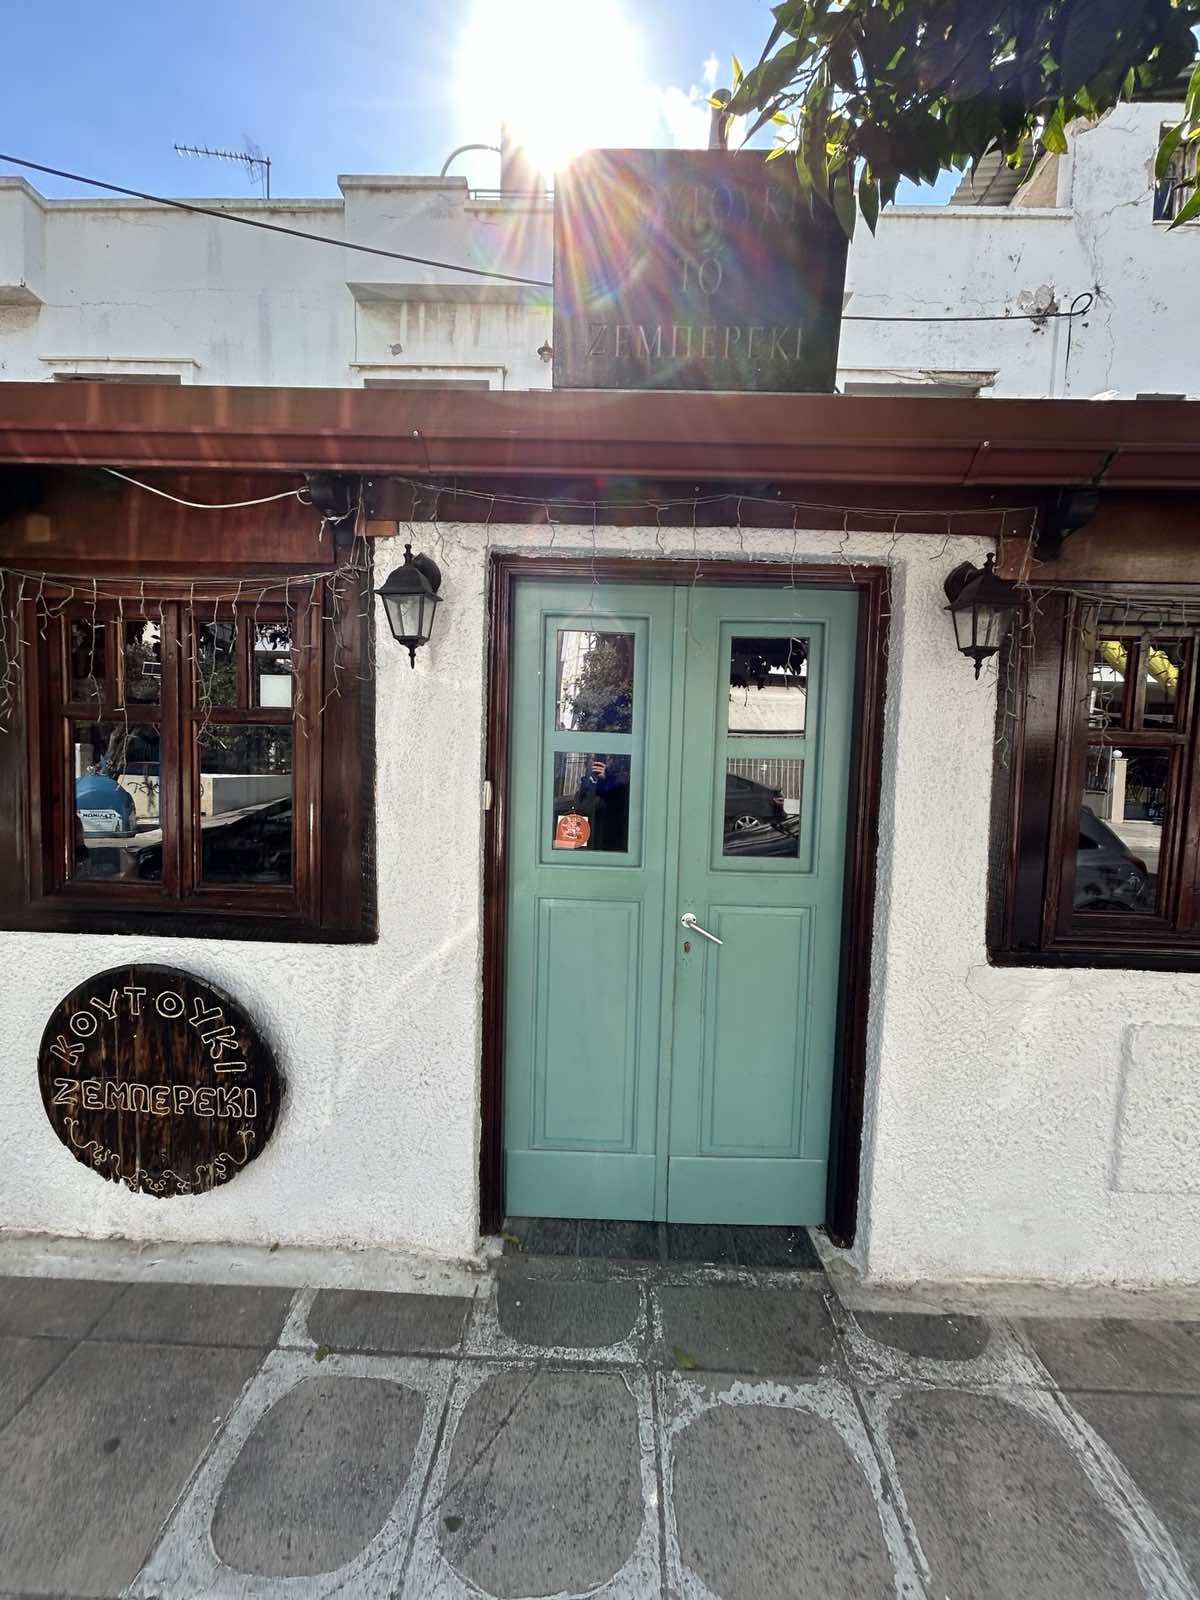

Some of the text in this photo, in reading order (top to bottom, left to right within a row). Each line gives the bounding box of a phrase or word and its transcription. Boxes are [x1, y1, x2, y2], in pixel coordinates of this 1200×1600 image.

[584, 322, 803, 361] ΖΕΜΠΕΡΕΚΙ
[50, 986, 247, 1073] ΚΟΥΤΟΥΚΙ
[53, 1077, 257, 1118] ΖΕΜΠΕΡΕΚΙ
